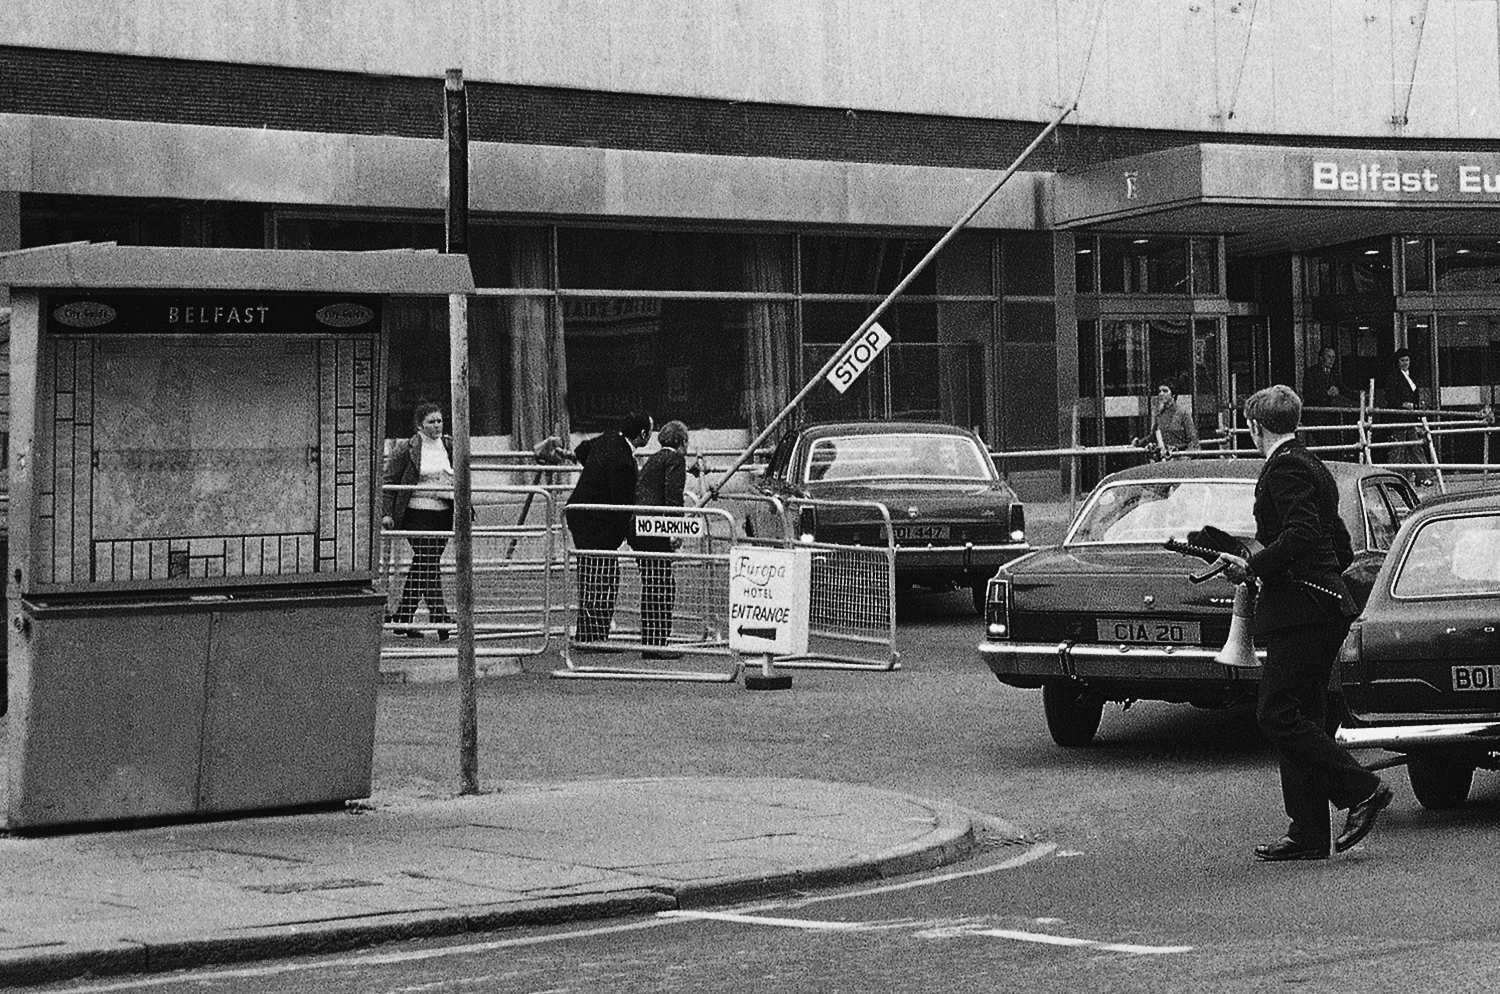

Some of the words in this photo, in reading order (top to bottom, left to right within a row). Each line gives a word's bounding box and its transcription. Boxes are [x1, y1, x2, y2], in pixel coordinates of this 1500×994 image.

[1313, 162, 1439, 192] Belfast
[168, 306, 269, 323] BELFAST
[835, 331, 880, 385] STOP
[638, 519, 652, 533] NO
[654, 520, 700, 534] PARKING
[732, 556, 786, 587] Europa
[743, 587, 773, 599] HOTEL
[731, 603, 790, 623] ENTRANCE
[1114, 624, 1148, 640] CIA
[1156, 625, 1183, 642] 20
[1455, 666, 1493, 689] BOI
